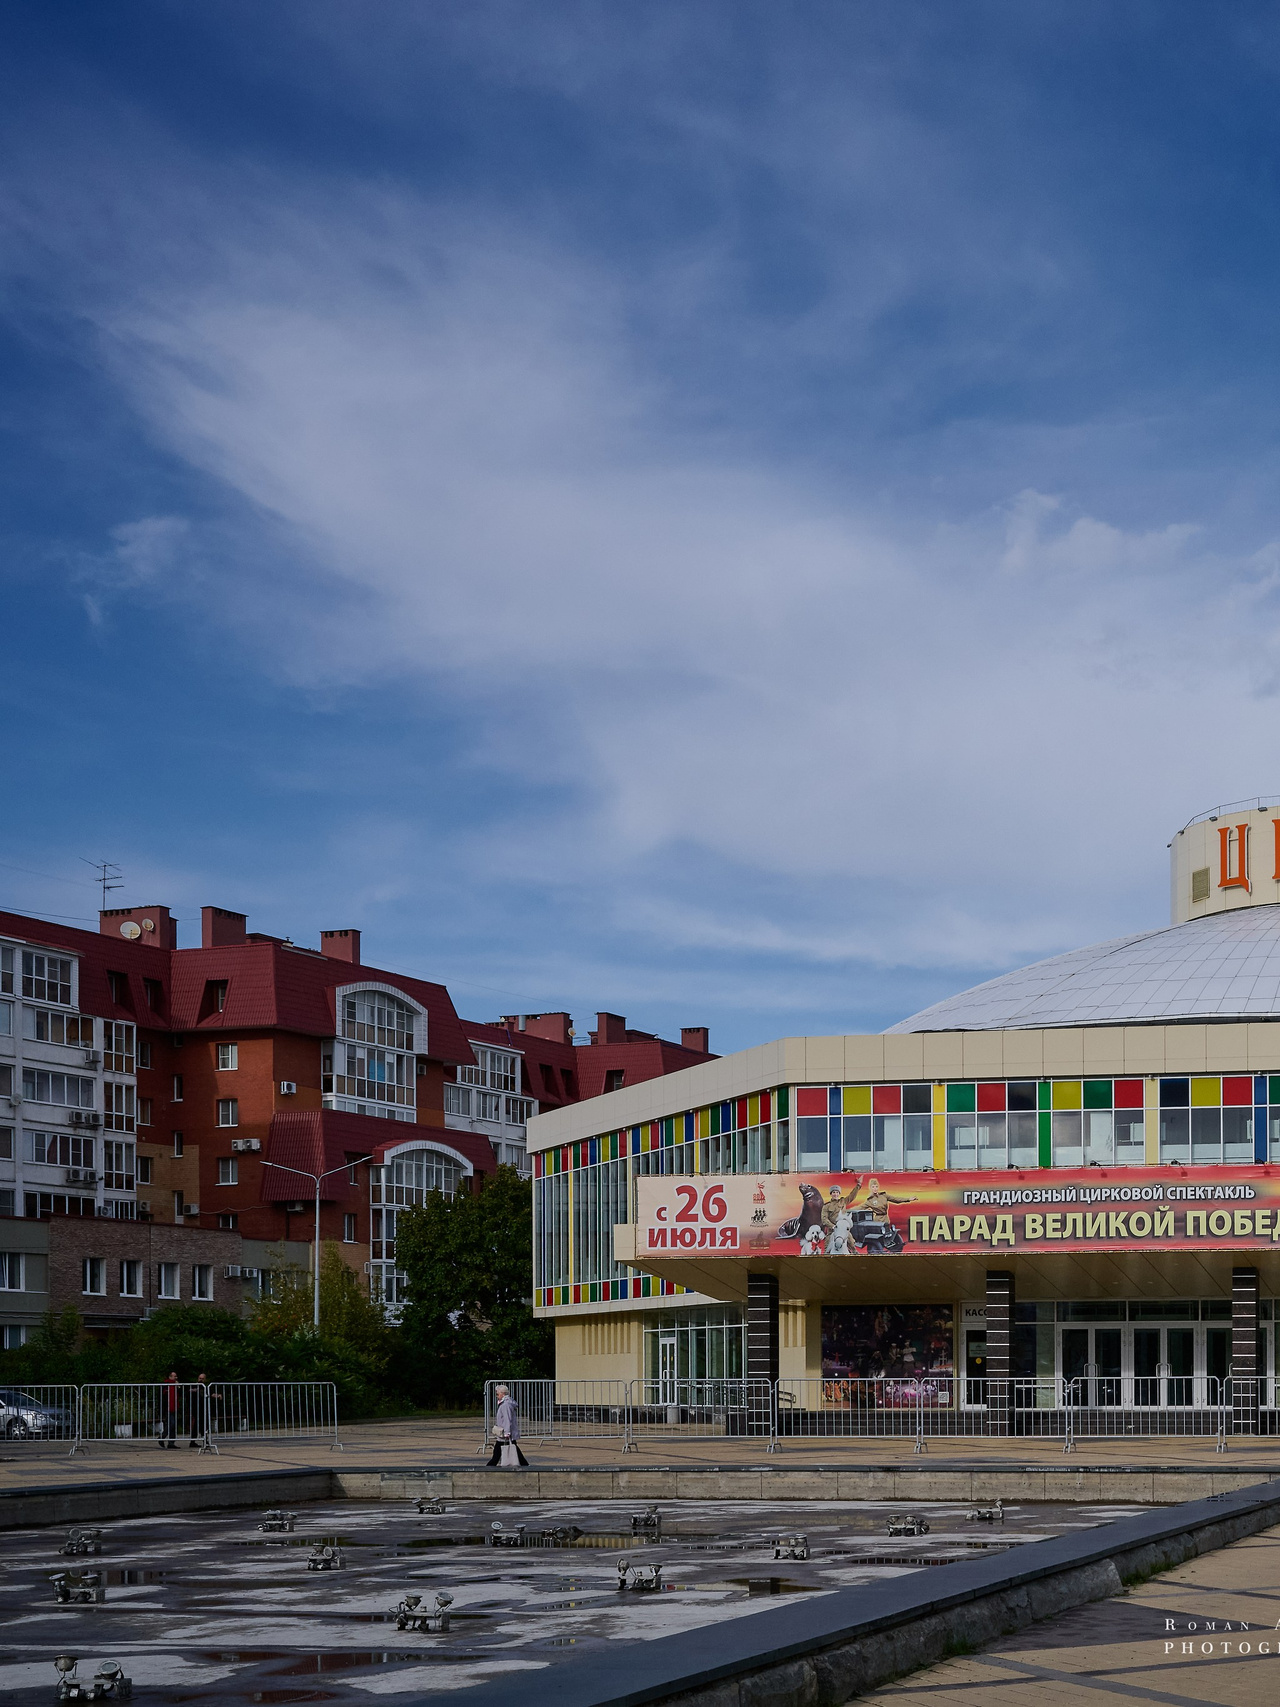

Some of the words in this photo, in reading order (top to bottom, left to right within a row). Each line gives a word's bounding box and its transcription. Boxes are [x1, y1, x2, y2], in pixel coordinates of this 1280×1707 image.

[675, 1184, 727, 1223] 26
[963, 1187, 1077, 1206] ГРАНДИОЗНЫЙ
[1080, 1184, 1163, 1204] ЦИРКОВОЙ
[1166, 1186, 1256, 1200] СПЕКТАКЛЬ
[909, 1213, 1015, 1246] ПАРАД
[1025, 1205, 1175, 1239] ВЕЛИКОЙ
[965, 1308, 988, 1317] КАСС
